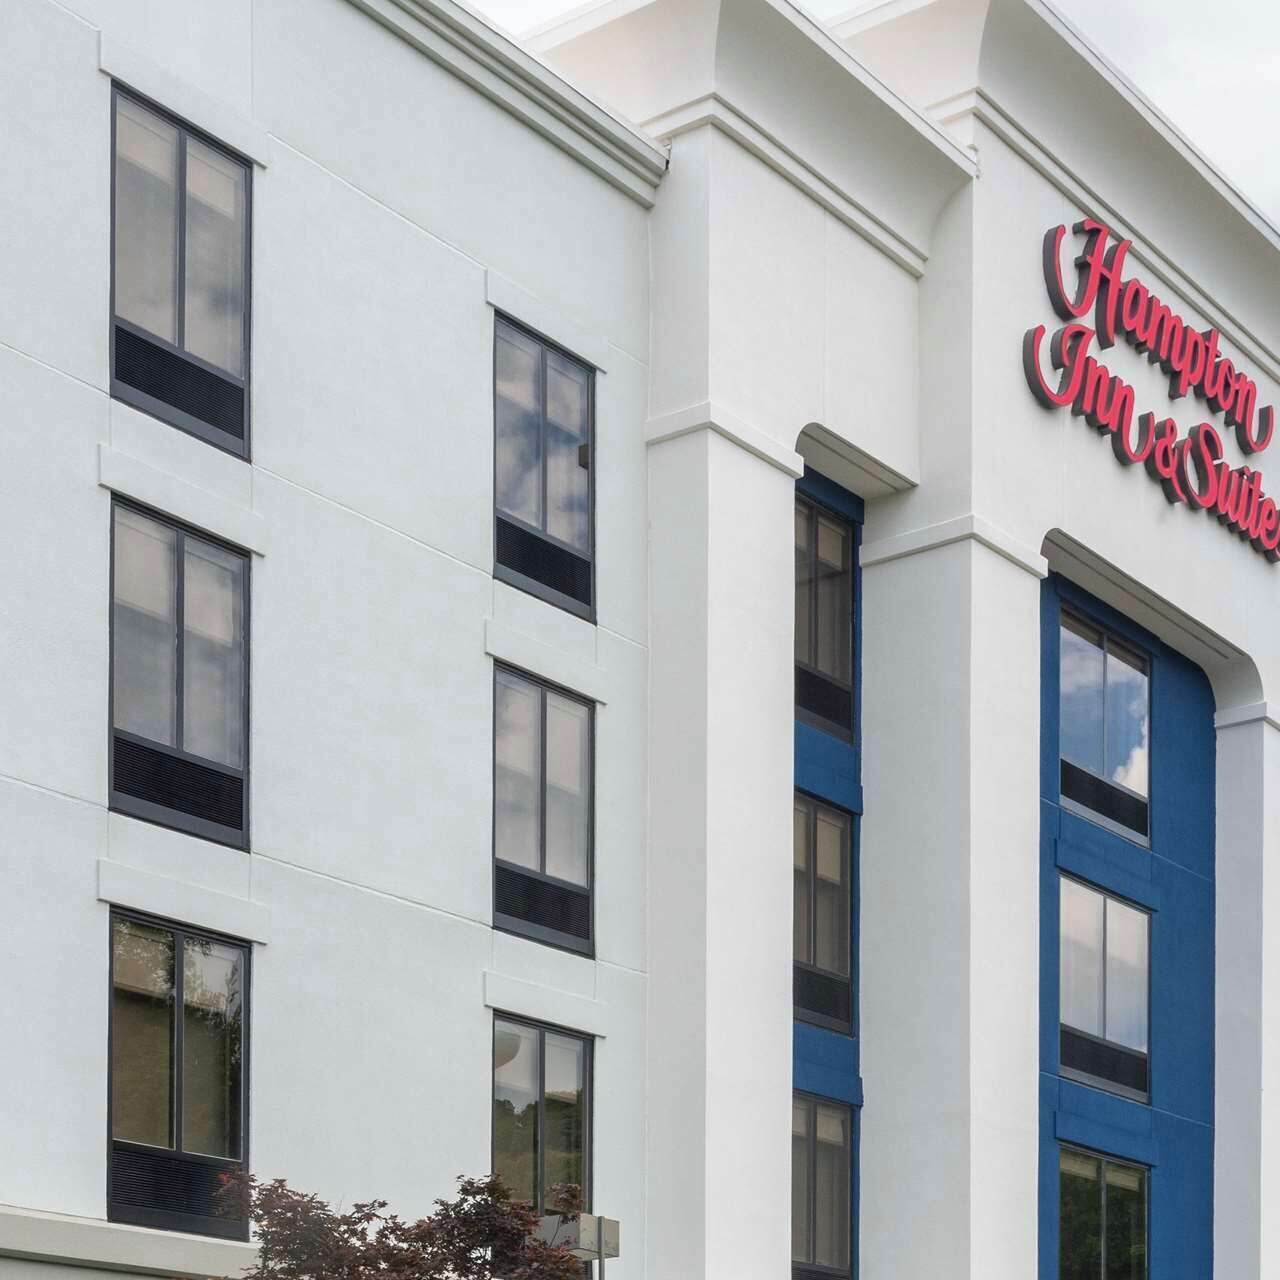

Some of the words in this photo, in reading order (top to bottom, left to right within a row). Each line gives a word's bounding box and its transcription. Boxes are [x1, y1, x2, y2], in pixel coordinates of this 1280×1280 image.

[1023, 323, 1156, 465] Inn
[1144, 417, 1188, 504] &
[1042, 218, 1274, 454] Hampton
